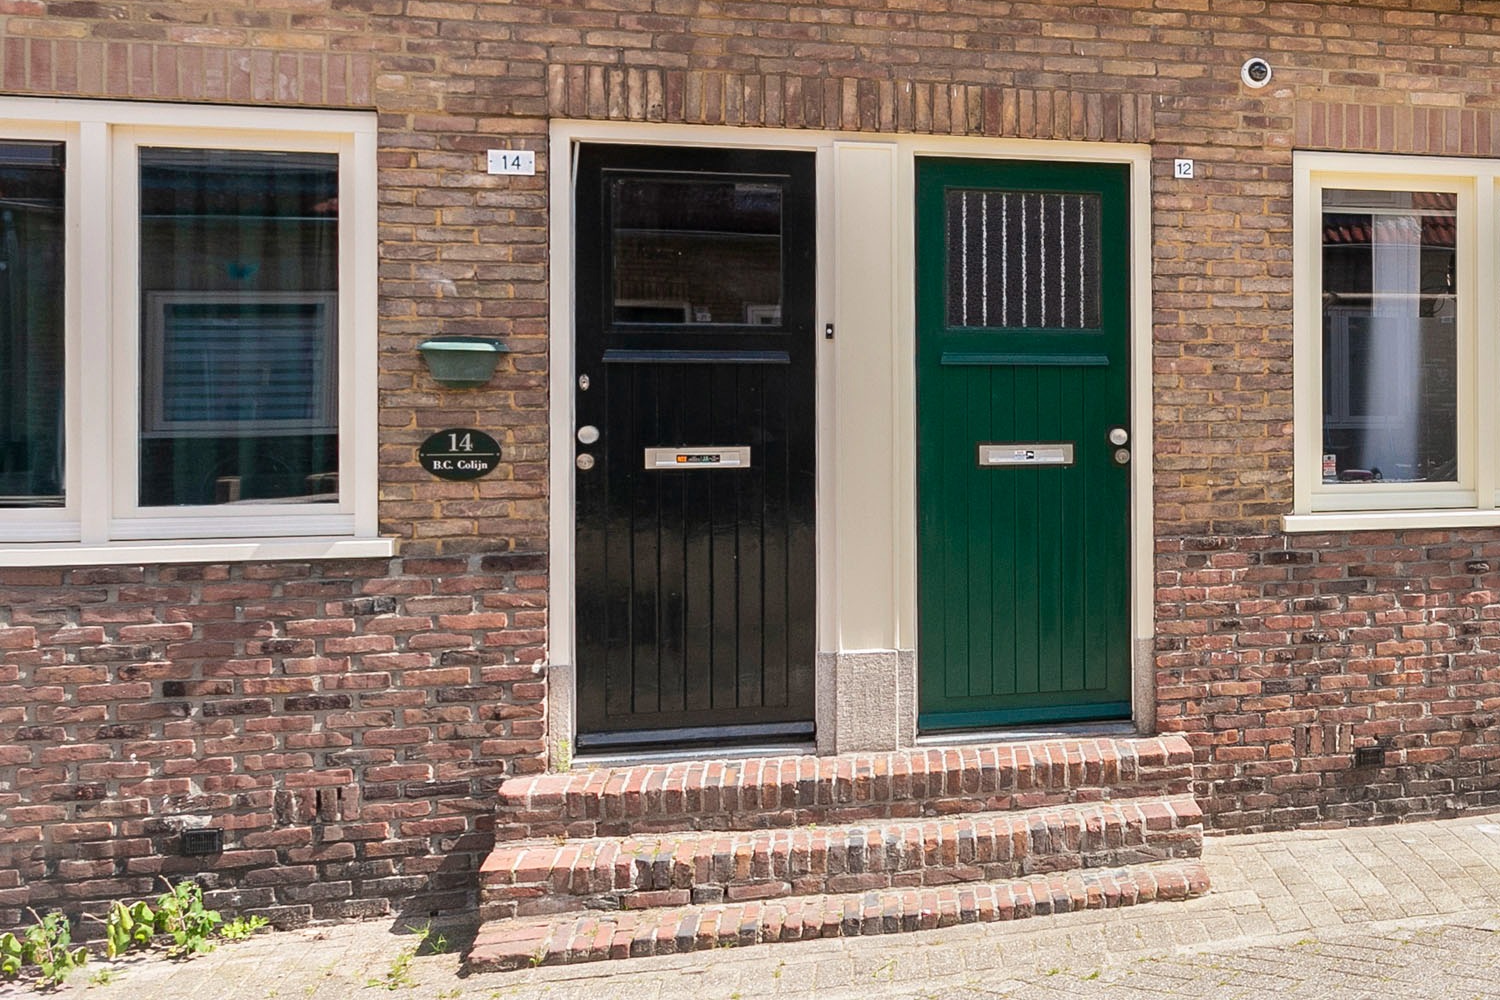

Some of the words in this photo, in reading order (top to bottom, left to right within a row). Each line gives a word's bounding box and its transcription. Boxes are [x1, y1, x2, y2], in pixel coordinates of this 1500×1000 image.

[502, 154, 521, 170] 14
[1177, 162, 1191, 175] 12
[447, 432, 474, 452] 14
[433, 460, 454, 470] B.C.
[457, 460, 488, 471] Colijn
